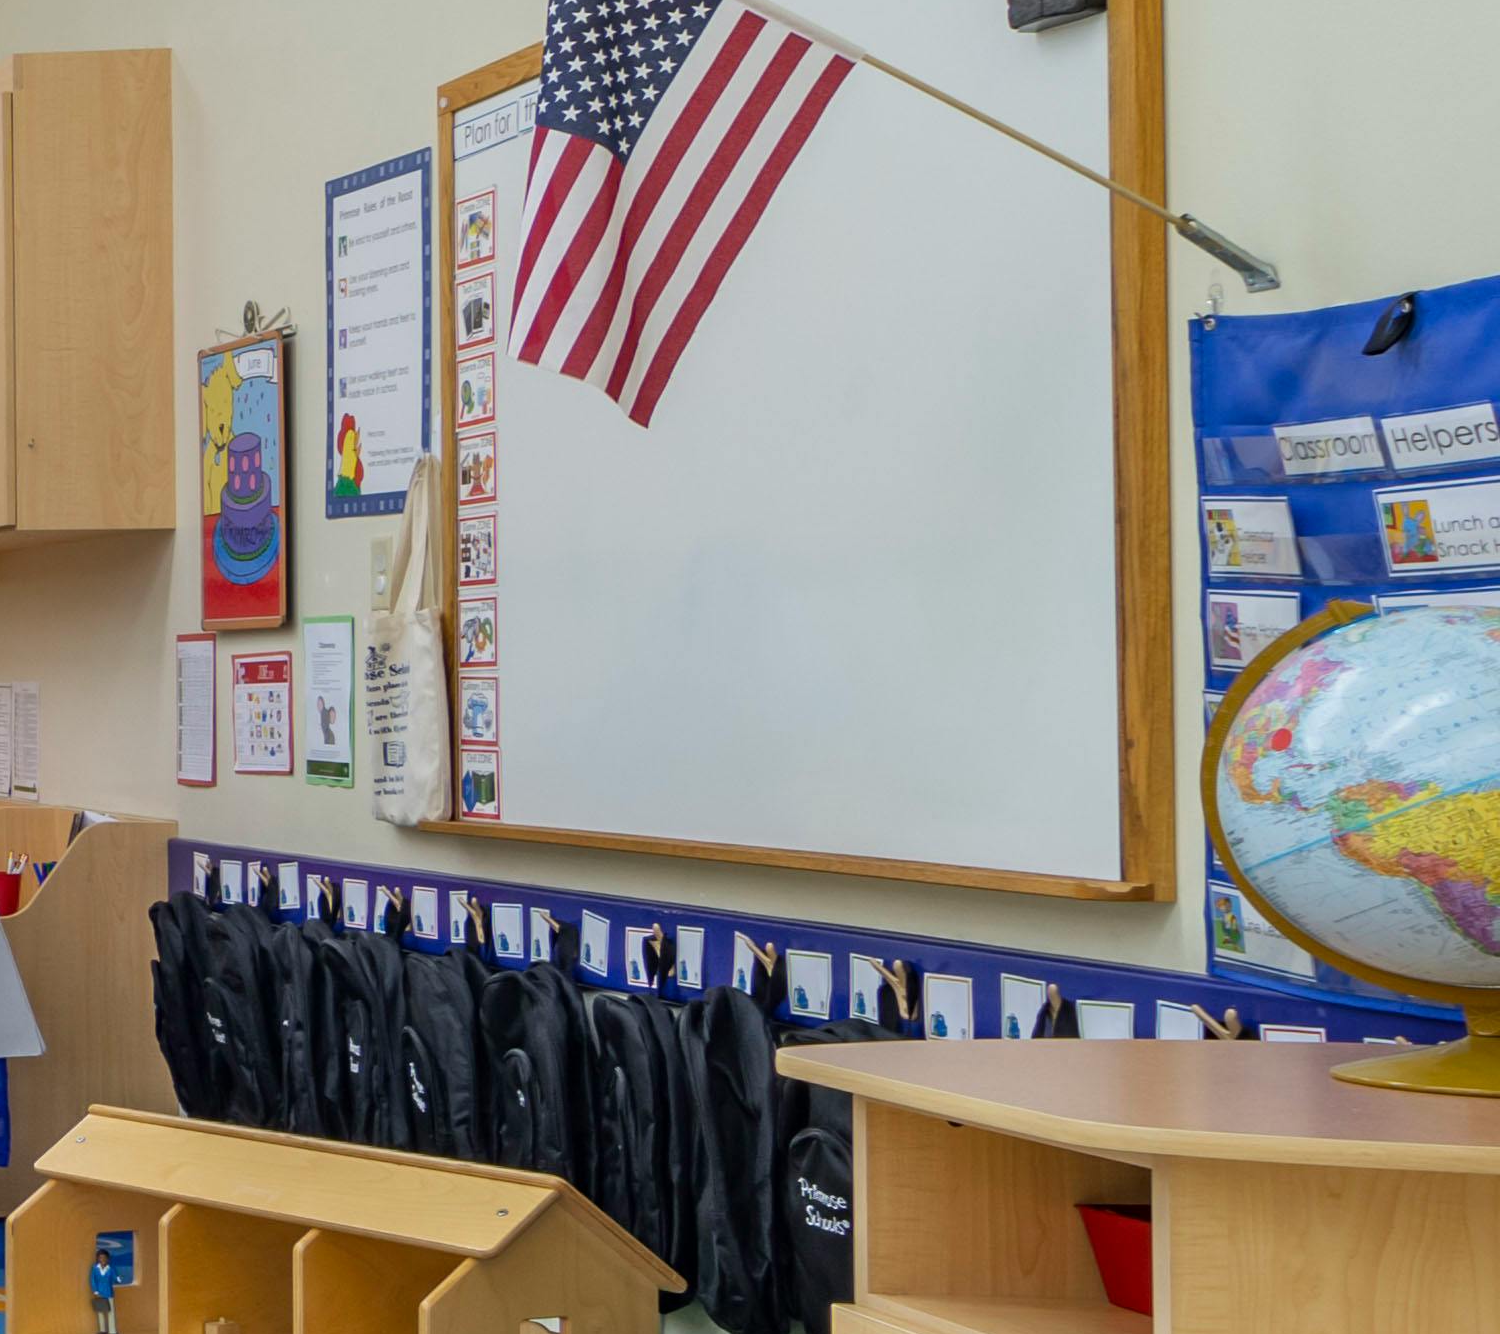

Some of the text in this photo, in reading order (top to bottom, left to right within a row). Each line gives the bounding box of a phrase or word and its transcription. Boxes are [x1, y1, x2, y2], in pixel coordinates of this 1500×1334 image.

[464, 122, 491, 147] Plan
[494, 112, 511, 138] for
[1279, 421, 1499, 461] Classroom Helpers
[1434, 515, 1483, 533] Lunch
[1437, 539, 1489, 557] Snack
